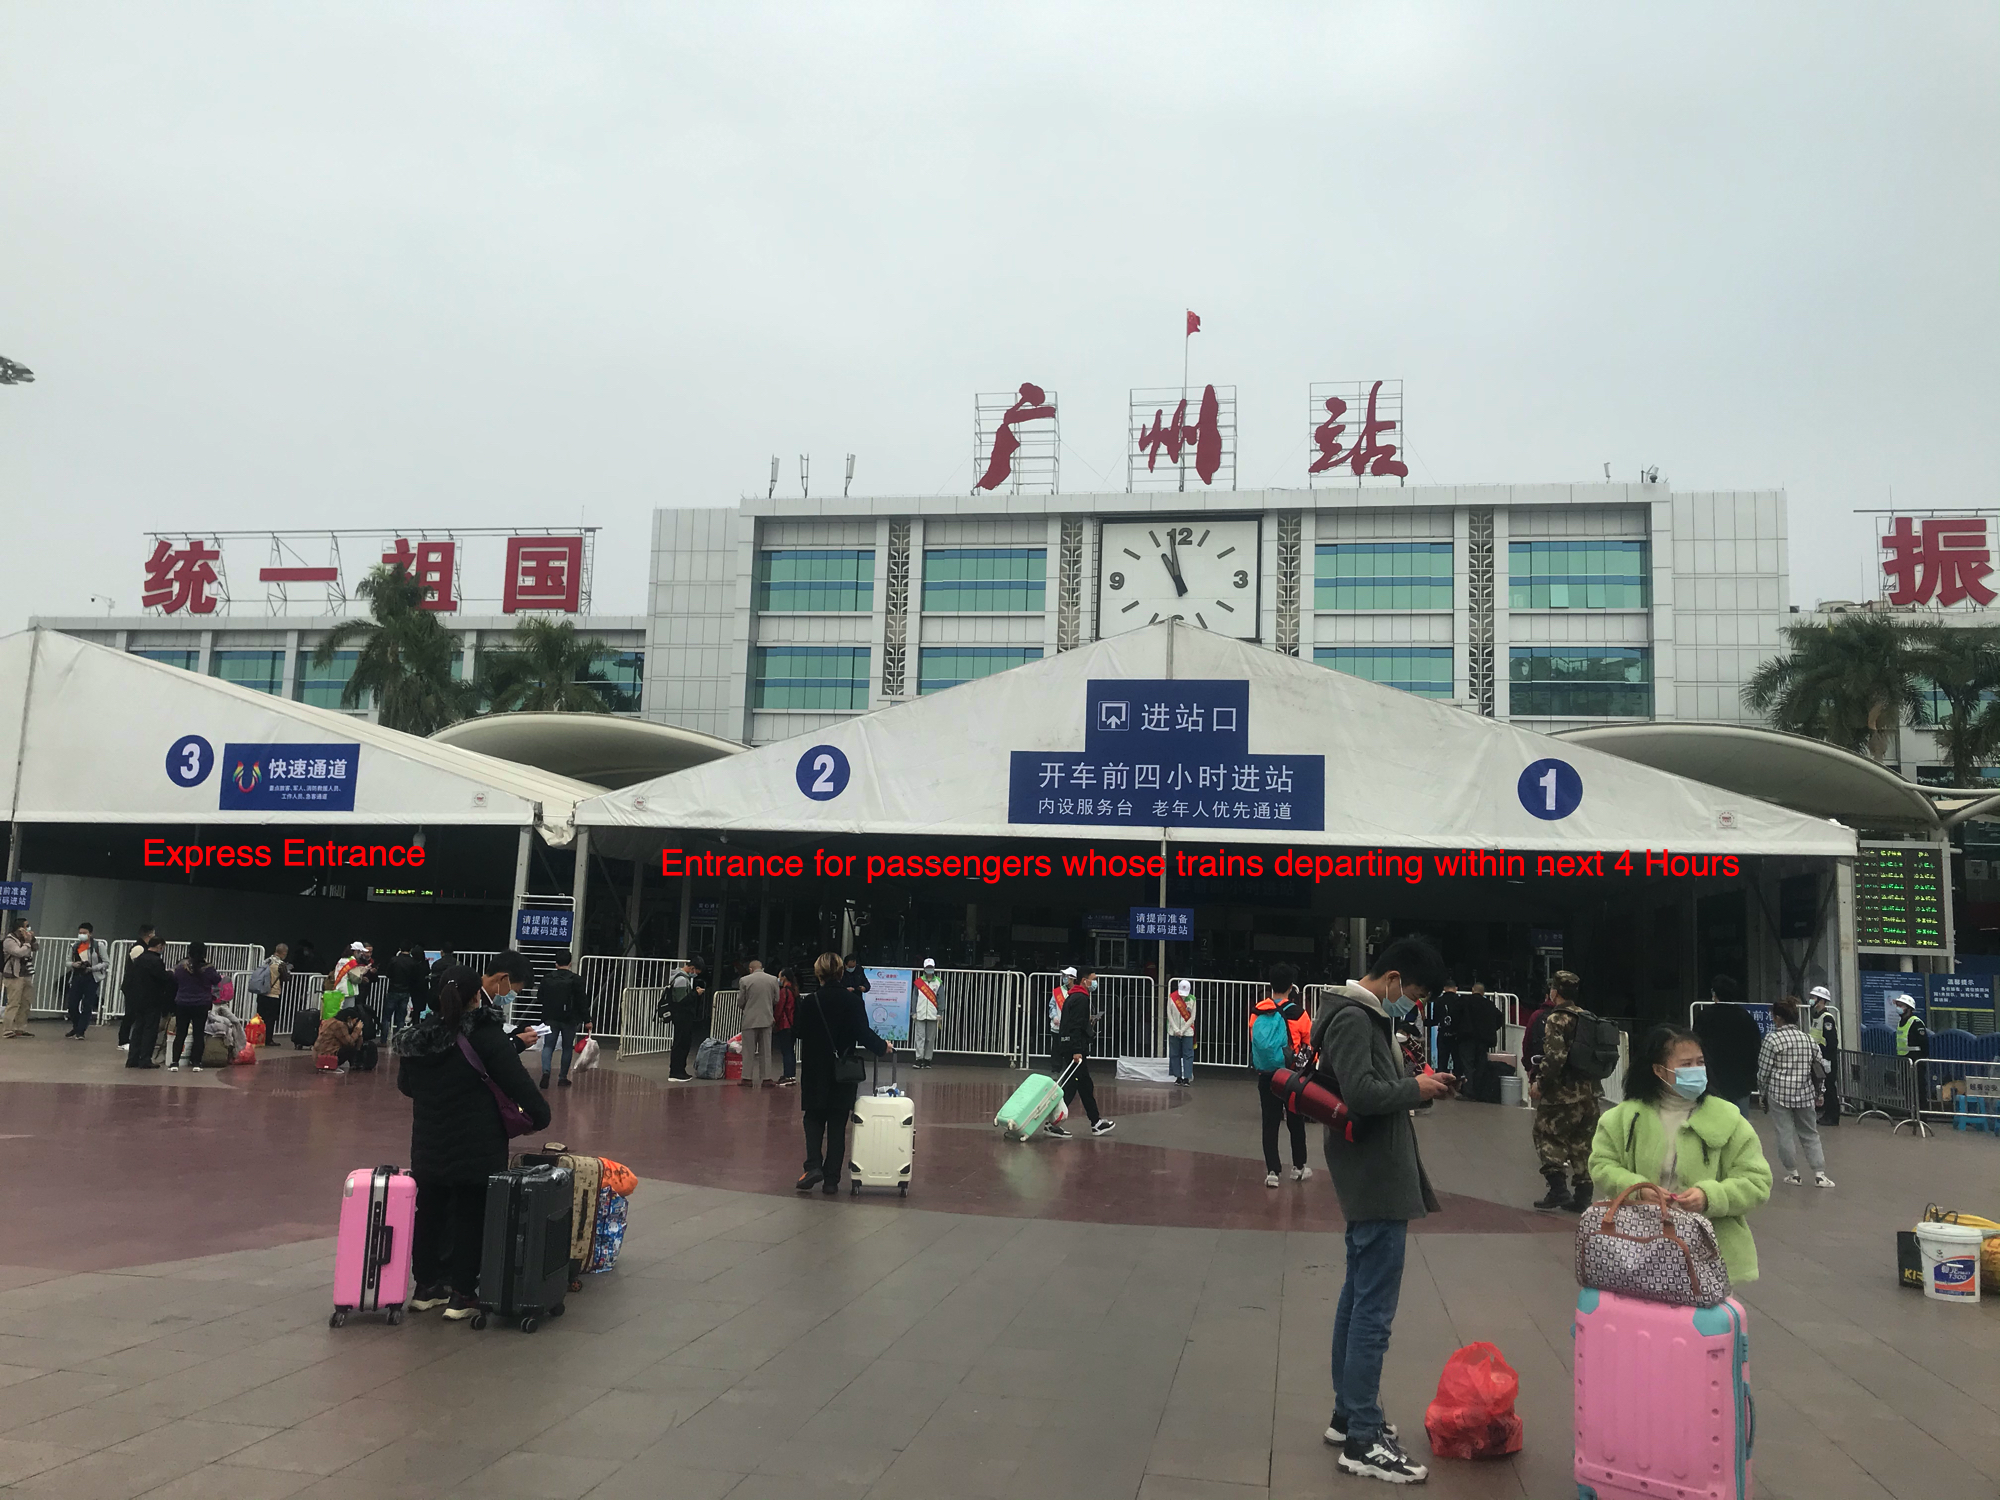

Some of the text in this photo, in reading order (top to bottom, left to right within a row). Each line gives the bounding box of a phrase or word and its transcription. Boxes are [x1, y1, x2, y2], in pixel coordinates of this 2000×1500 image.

[972, 380, 1409, 491] 广州站
[1166, 527, 1193, 546] 12
[1882, 516, 1998, 607] 振
[142, 536, 585, 615] 统一祖国
[1109, 571, 1125, 590] 9
[1233, 569, 1249, 589] 3
[1140, 702, 1237, 732] 进站口
[180, 742, 201, 780] 3
[268, 758, 348, 779] 快速通道
[811, 753, 835, 793] 2
[1038, 761, 1294, 793] 开车前四小时进站
[1539, 768, 1557, 811] 1
[1038, 798, 1293, 820] 内设服务台 老年人优先通道
[0, 886, 27, 896] 前准备
[522, 915, 568, 926] 请提前准备
[1136, 912, 1188, 924] 请提前准备
[521, 925, 568, 936] 健康码进站
[1136, 923, 1188, 935] 健康码进站
